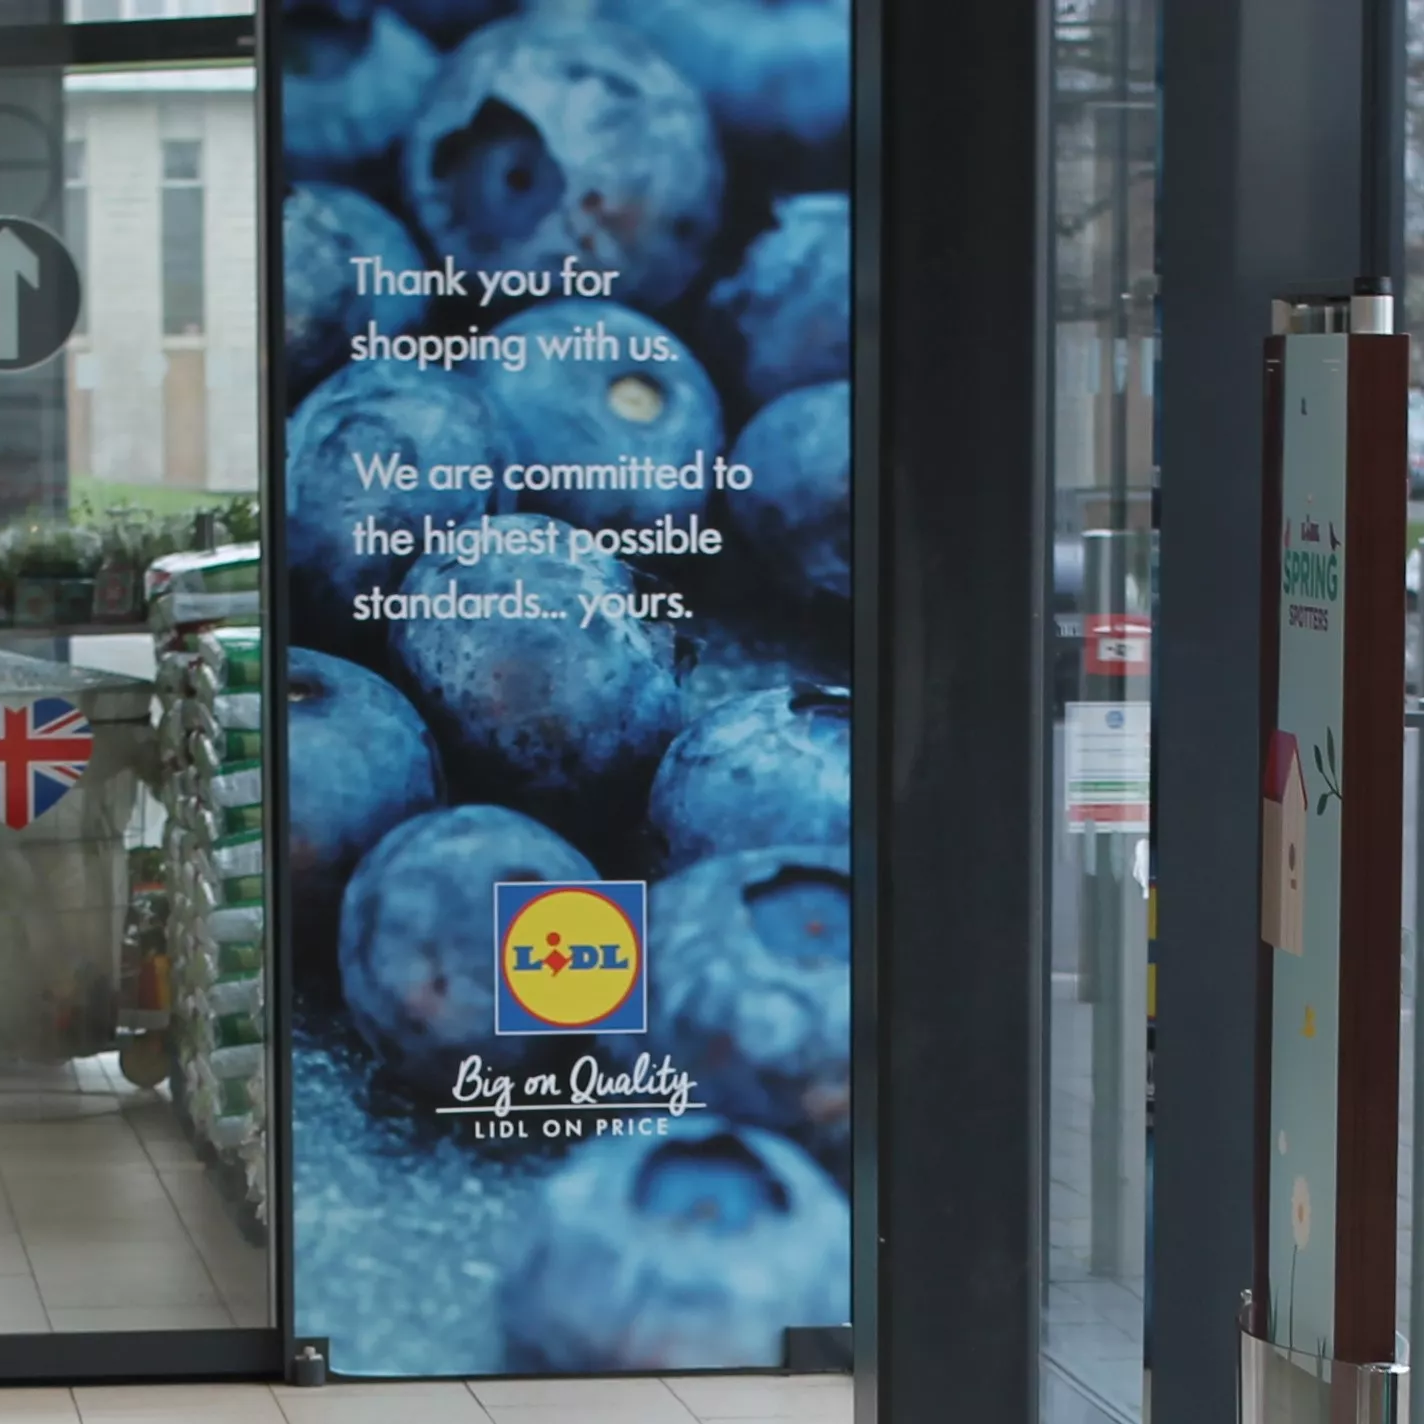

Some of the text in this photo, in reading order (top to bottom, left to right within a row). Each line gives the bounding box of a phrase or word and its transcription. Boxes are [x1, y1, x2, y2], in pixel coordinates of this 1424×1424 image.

[350, 256, 620, 306] Thank you for
[350, 320, 678, 371] shopping with us.
[352, 449, 753, 490] We are committed to
[352, 514, 723, 566] the highest possible
[1283, 550, 1338, 601] SPRING
[353, 579, 693, 630] standards... yours.
[1289, 604, 1329, 632] SPOTTERS
[452, 1052, 698, 1117] Big on Quality
[475, 1117, 669, 1139] LIDL ON PRICE
